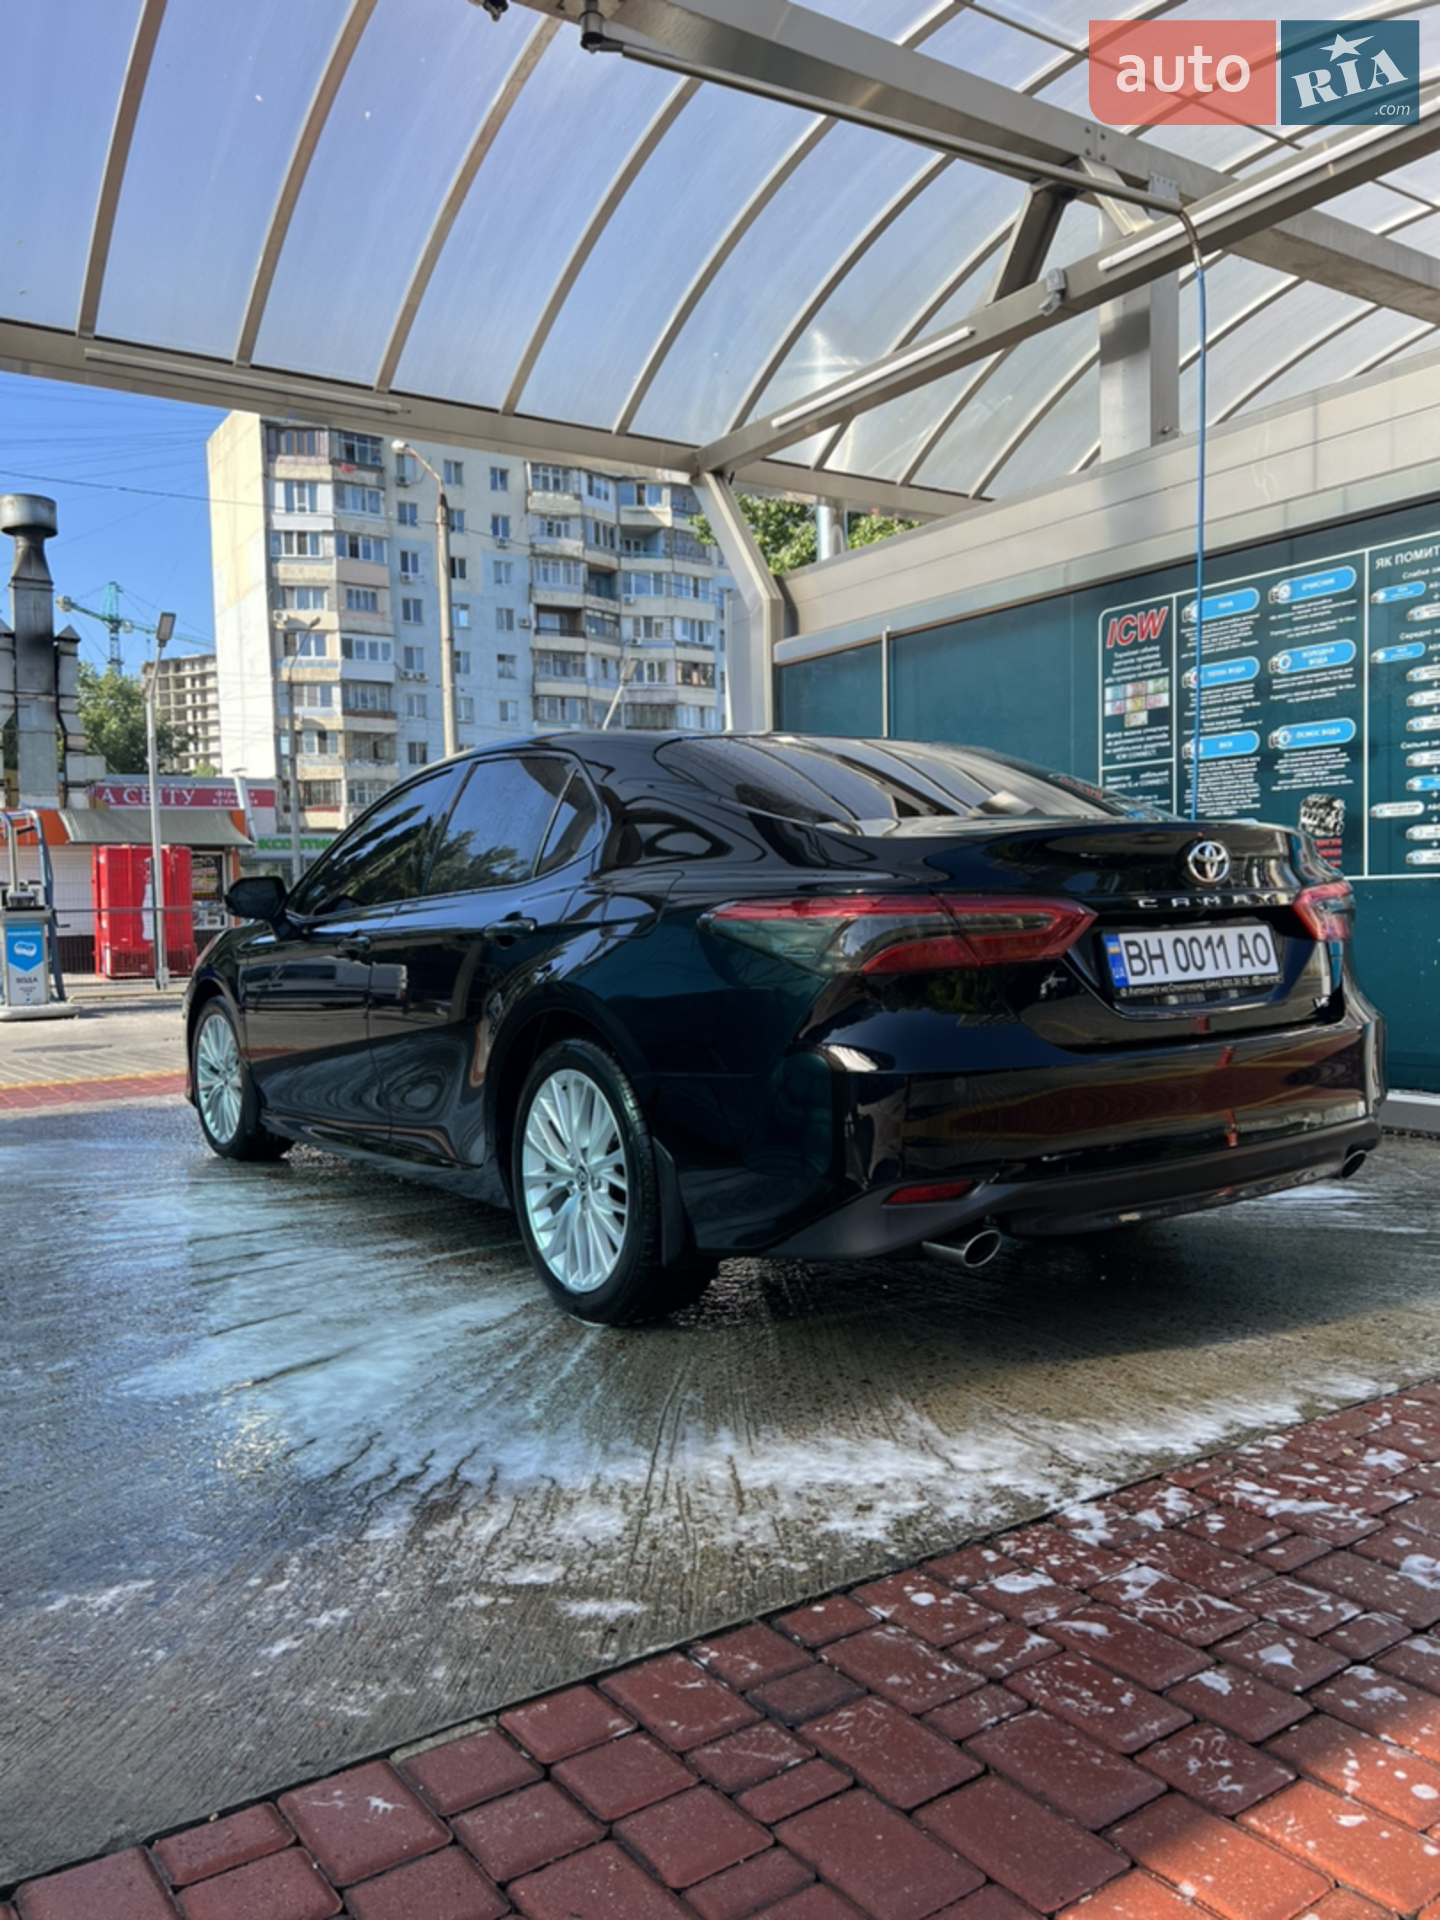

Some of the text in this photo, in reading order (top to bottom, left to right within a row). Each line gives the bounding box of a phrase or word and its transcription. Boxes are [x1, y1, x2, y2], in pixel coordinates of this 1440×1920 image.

[1375, 555, 1393, 570] ЯК
[1105, 606, 1169, 649] ICW
[1137, 893, 1272, 908] CAMRY
[1124, 932, 1272, 977] BH 0011 AO
[15, 976, 38, 984] ВОДА
